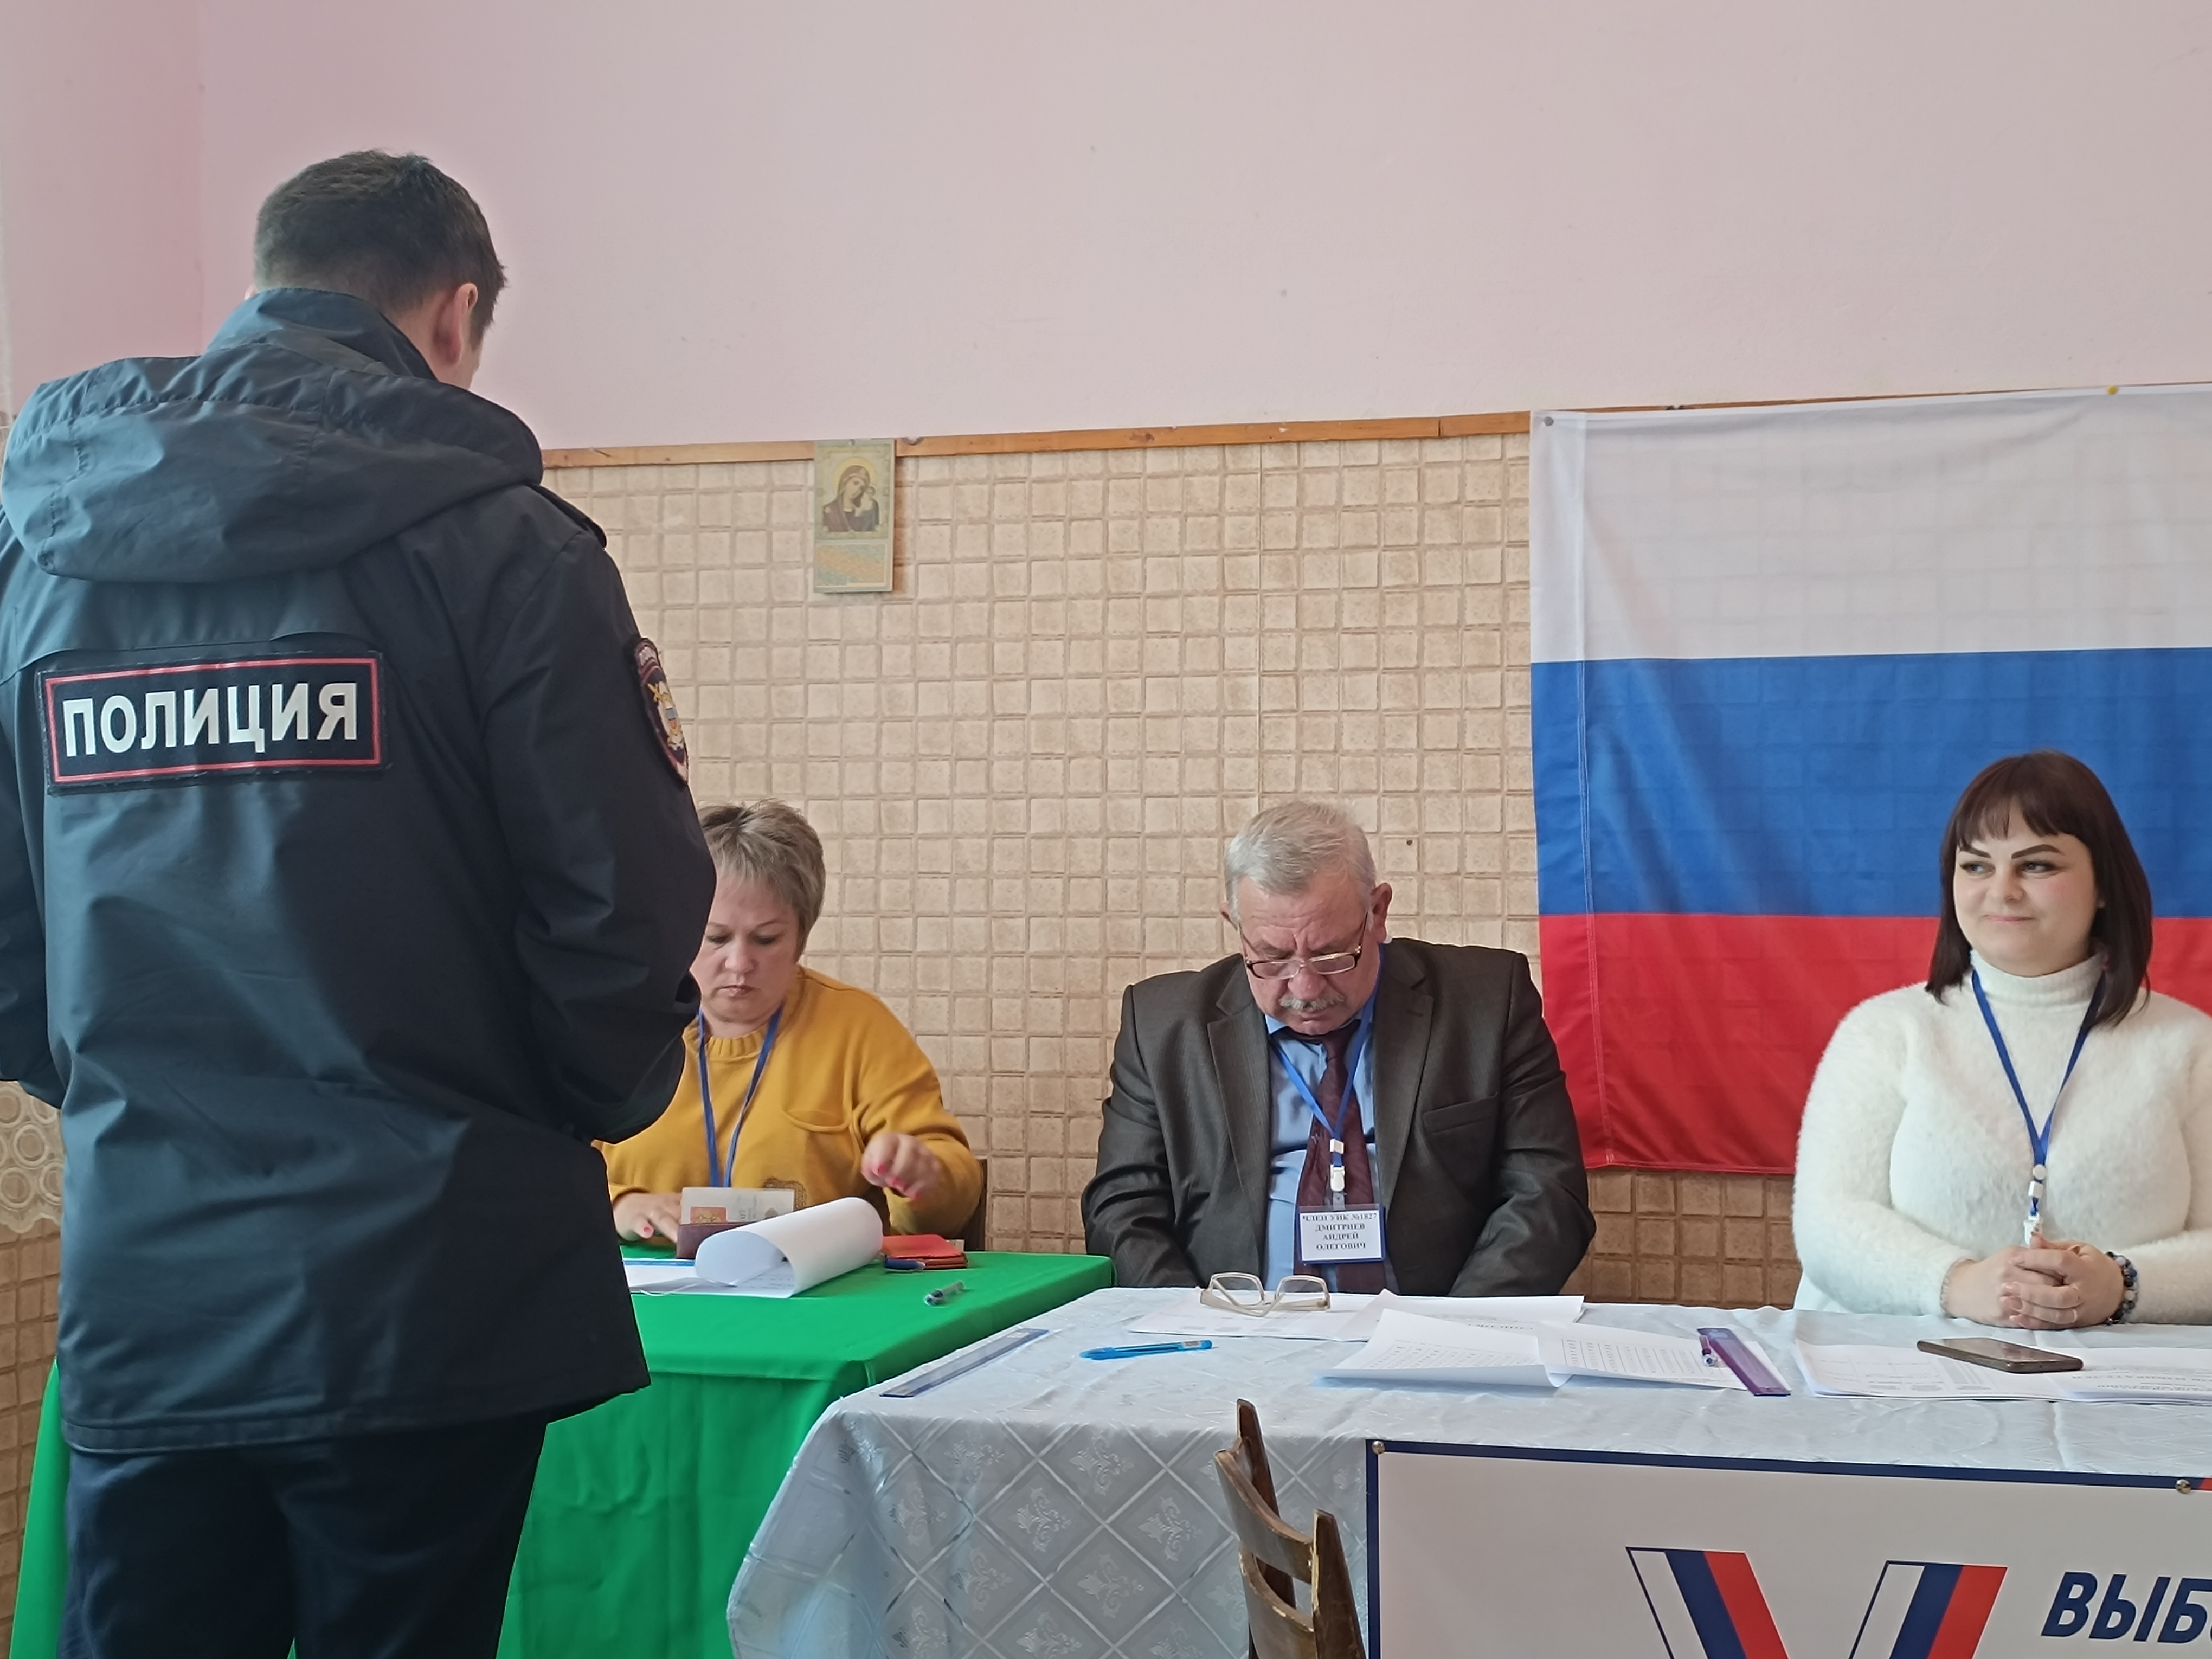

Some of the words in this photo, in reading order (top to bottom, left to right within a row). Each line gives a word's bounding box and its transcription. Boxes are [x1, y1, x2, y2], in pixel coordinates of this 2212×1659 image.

[62, 681, 358, 758] ПОЛИЦИЯ
[1315, 1223, 1365, 1232] ДМИТРИЕВ
[1323, 1231, 1359, 1240] АНДРЕЙ
[1316, 1242, 1366, 1250] ОЛЕГОВИЧ
[2041, 1571, 2212, 1643] ВЫБ
